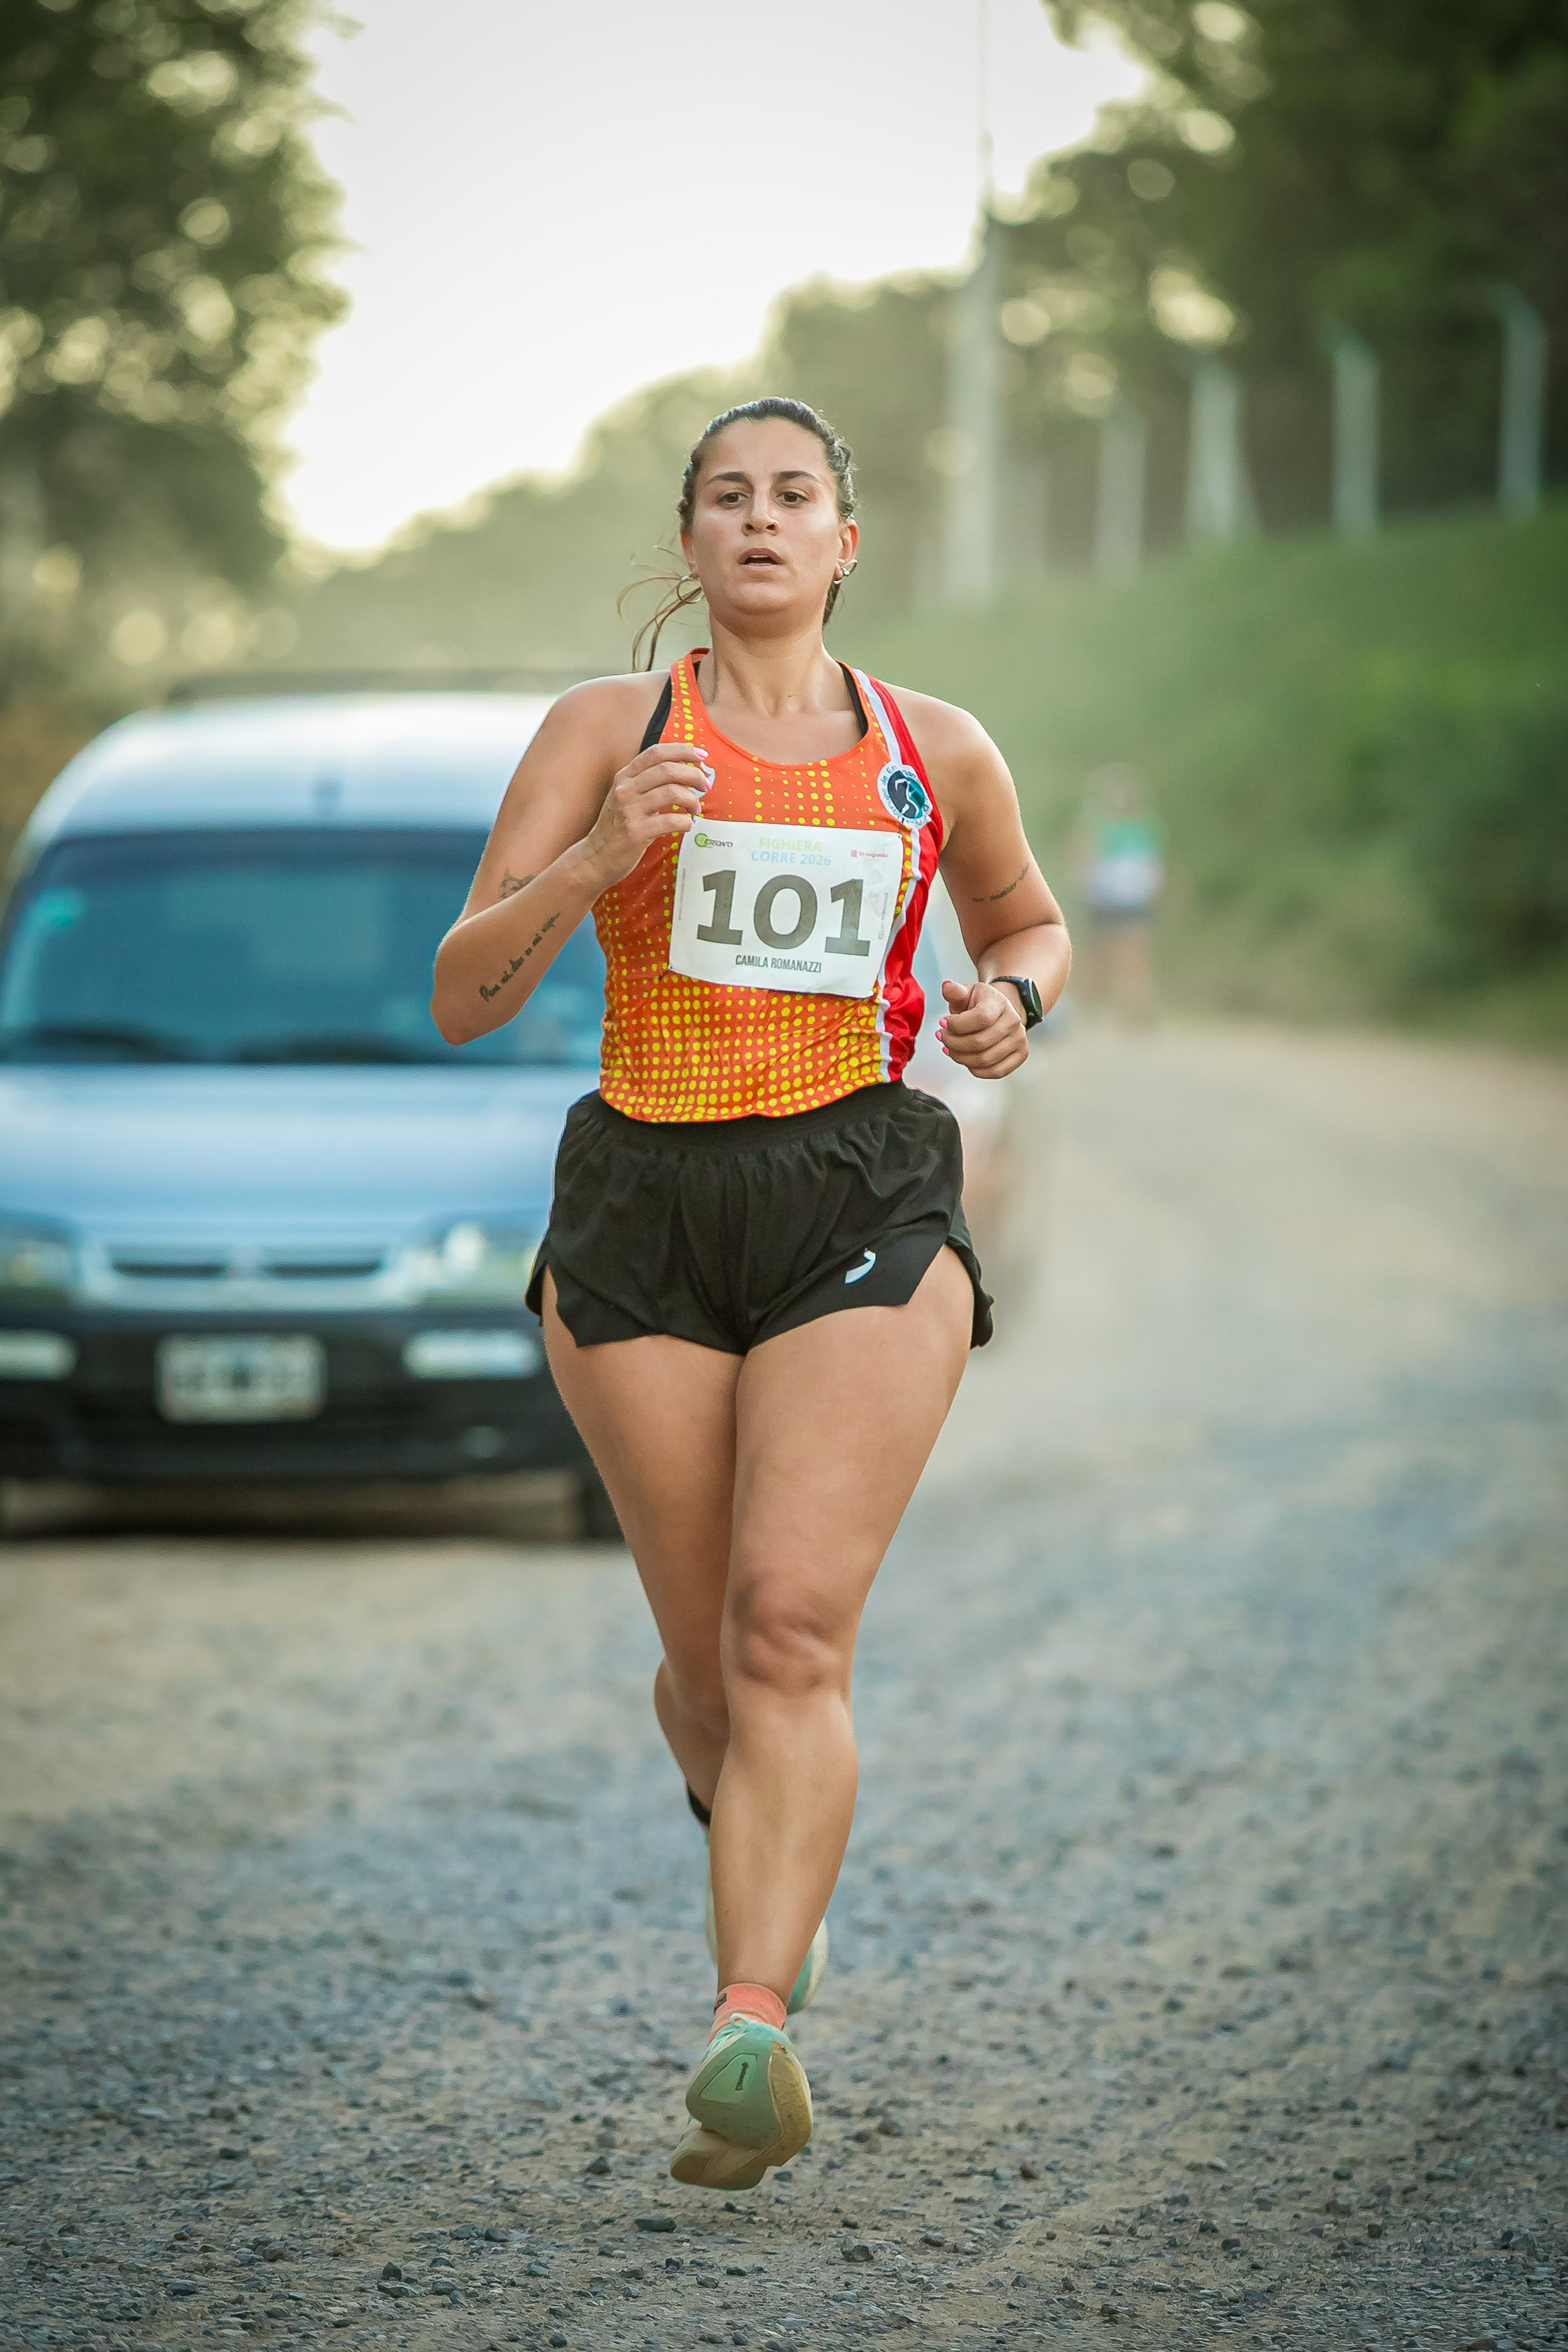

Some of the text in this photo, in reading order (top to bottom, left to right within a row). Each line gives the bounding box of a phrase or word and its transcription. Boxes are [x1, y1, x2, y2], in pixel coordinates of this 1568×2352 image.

[759, 837, 822, 852] FIGHIERA
[751, 851, 832, 866] CORRE 2026
[696, 869, 870, 957] 101
[735, 954, 822, 973] CAMILA ROMANAZZI
